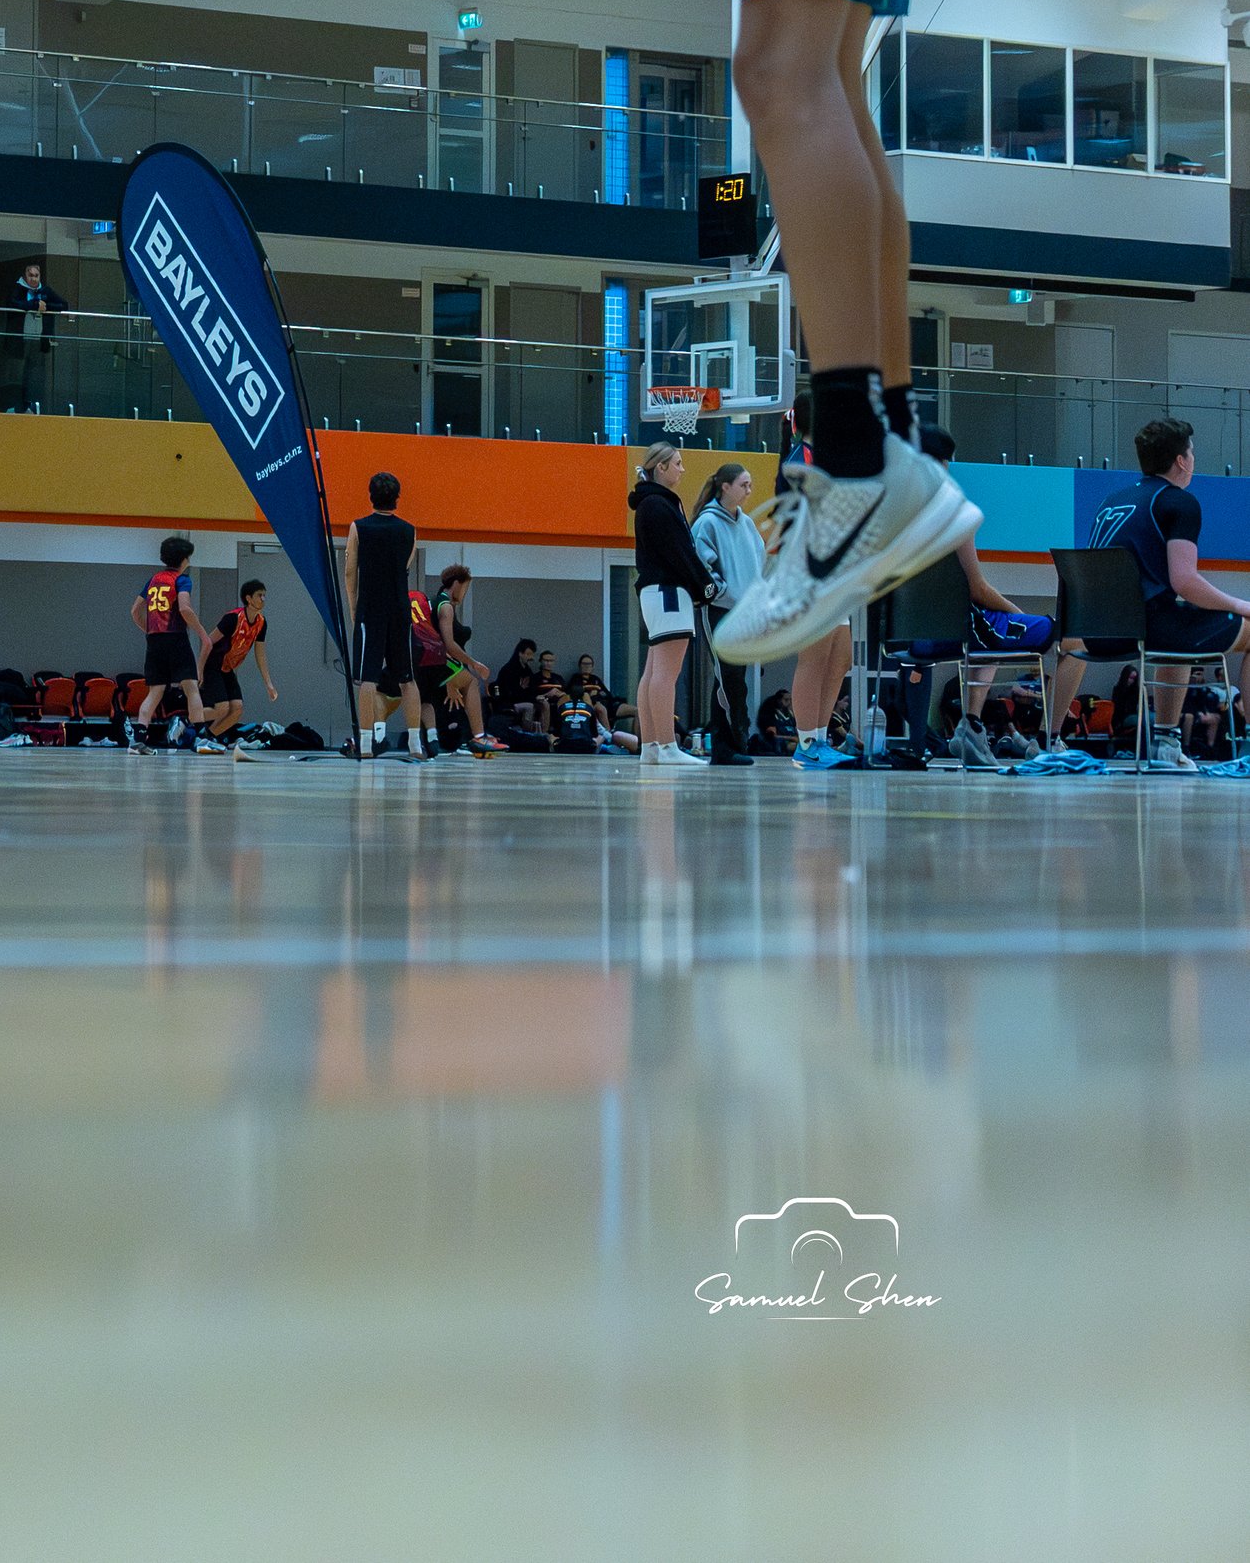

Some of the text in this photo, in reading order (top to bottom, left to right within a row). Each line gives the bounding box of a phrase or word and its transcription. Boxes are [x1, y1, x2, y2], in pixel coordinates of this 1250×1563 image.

[715, 178, 744, 202] 1:20
[145, 220, 268, 418] BAYLEYS
[1088, 504, 1137, 549] 17
[148, 586, 170, 612] 35
